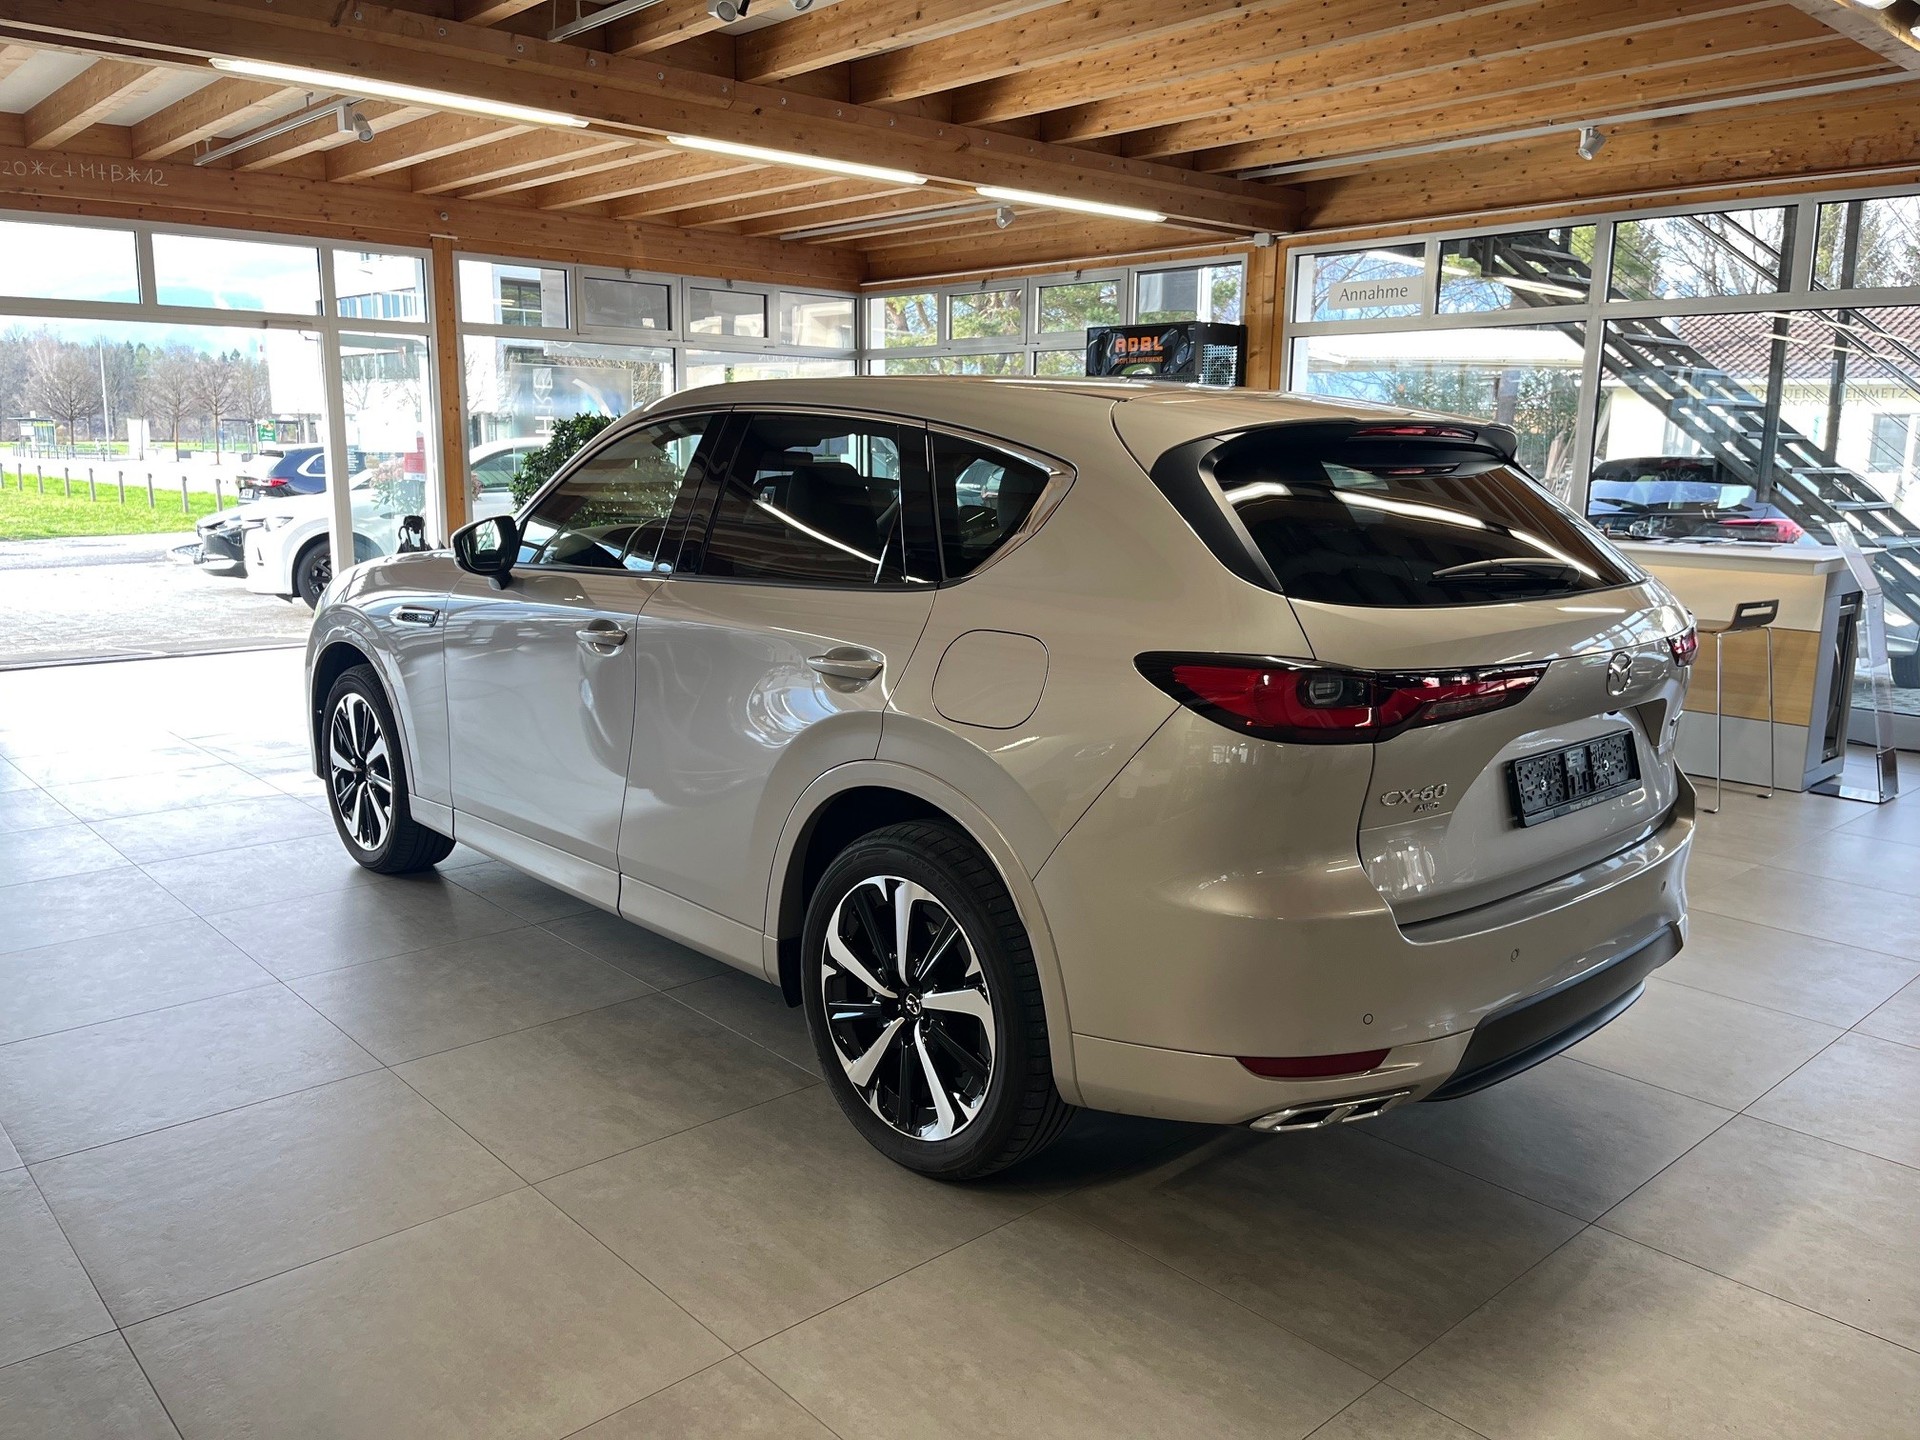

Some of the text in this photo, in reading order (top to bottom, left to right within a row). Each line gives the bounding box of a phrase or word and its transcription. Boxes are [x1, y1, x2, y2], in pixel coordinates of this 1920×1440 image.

[1339, 285, 1408, 301] Annahme
[1115, 336, 1163, 353] ADBL
[1836, 388, 1909, 399] EINMETZ
[1381, 783, 1448, 806] CX-60
